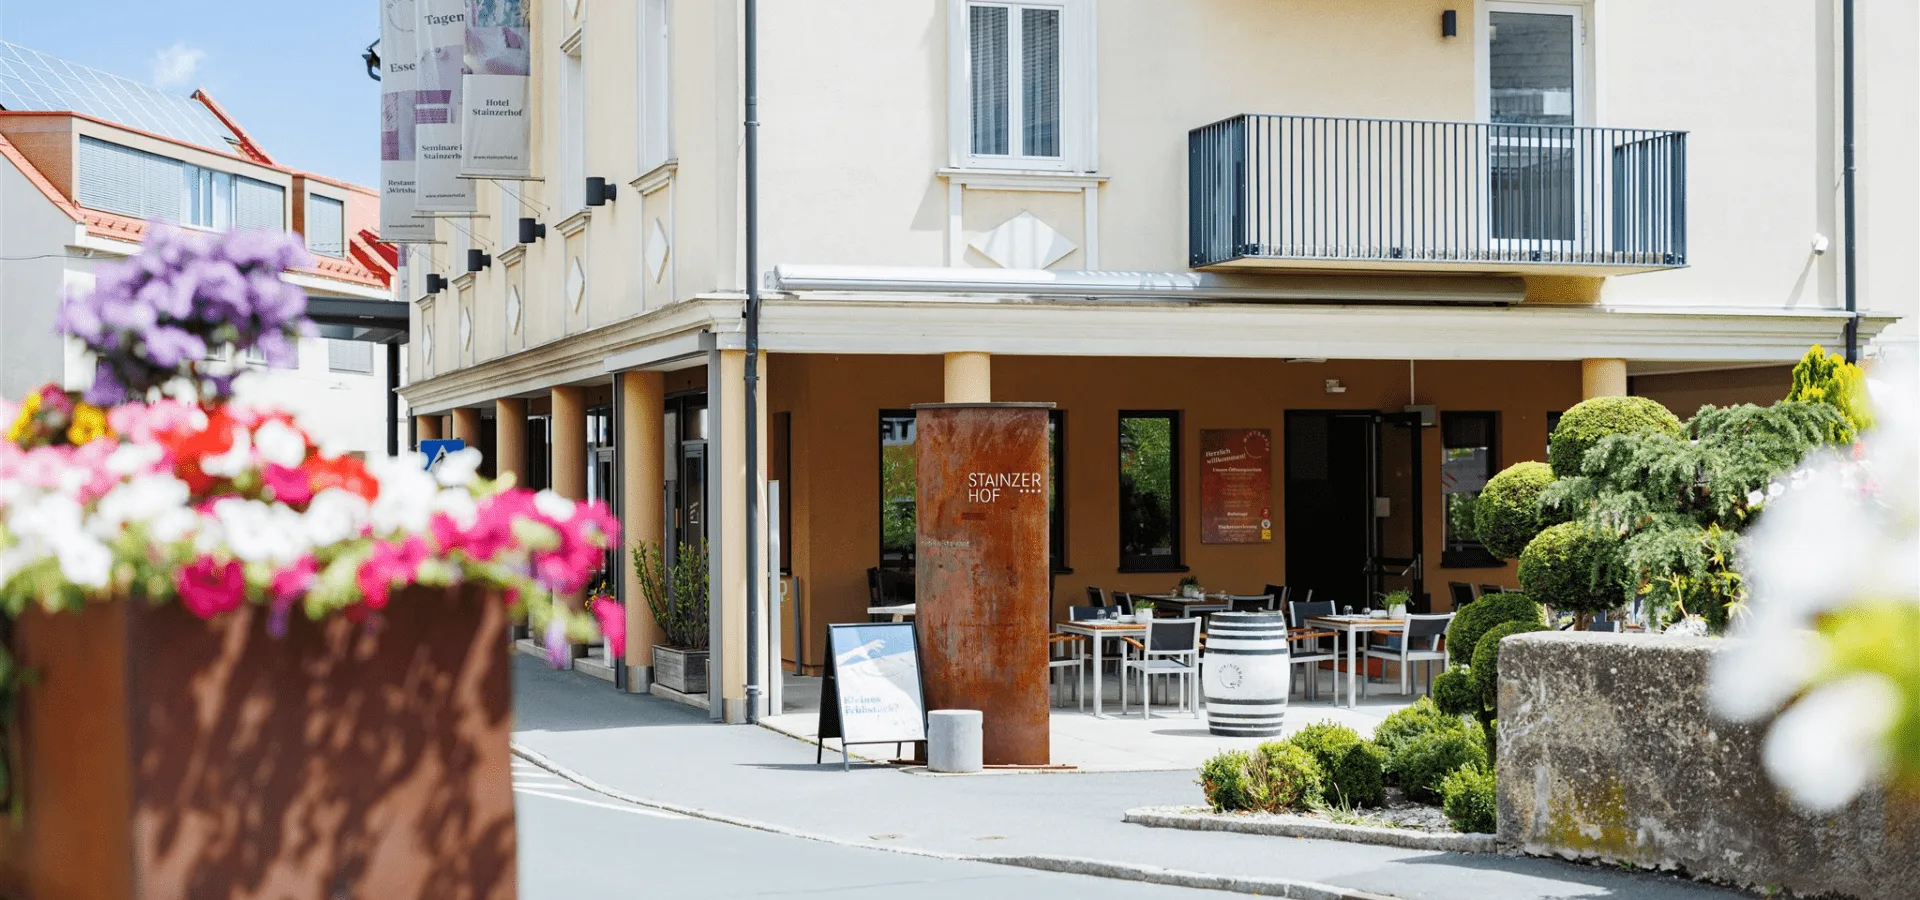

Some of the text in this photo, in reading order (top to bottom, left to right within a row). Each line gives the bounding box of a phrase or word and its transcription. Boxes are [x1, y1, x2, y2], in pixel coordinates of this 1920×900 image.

[472, 108, 523, 116] Stainzerhof
[1205, 448, 1231, 457] Herzlich
[1206, 454, 1246, 464] willkommen!
[968, 472, 1041, 487] STAINZER
[968, 489, 1001, 503] HOF
